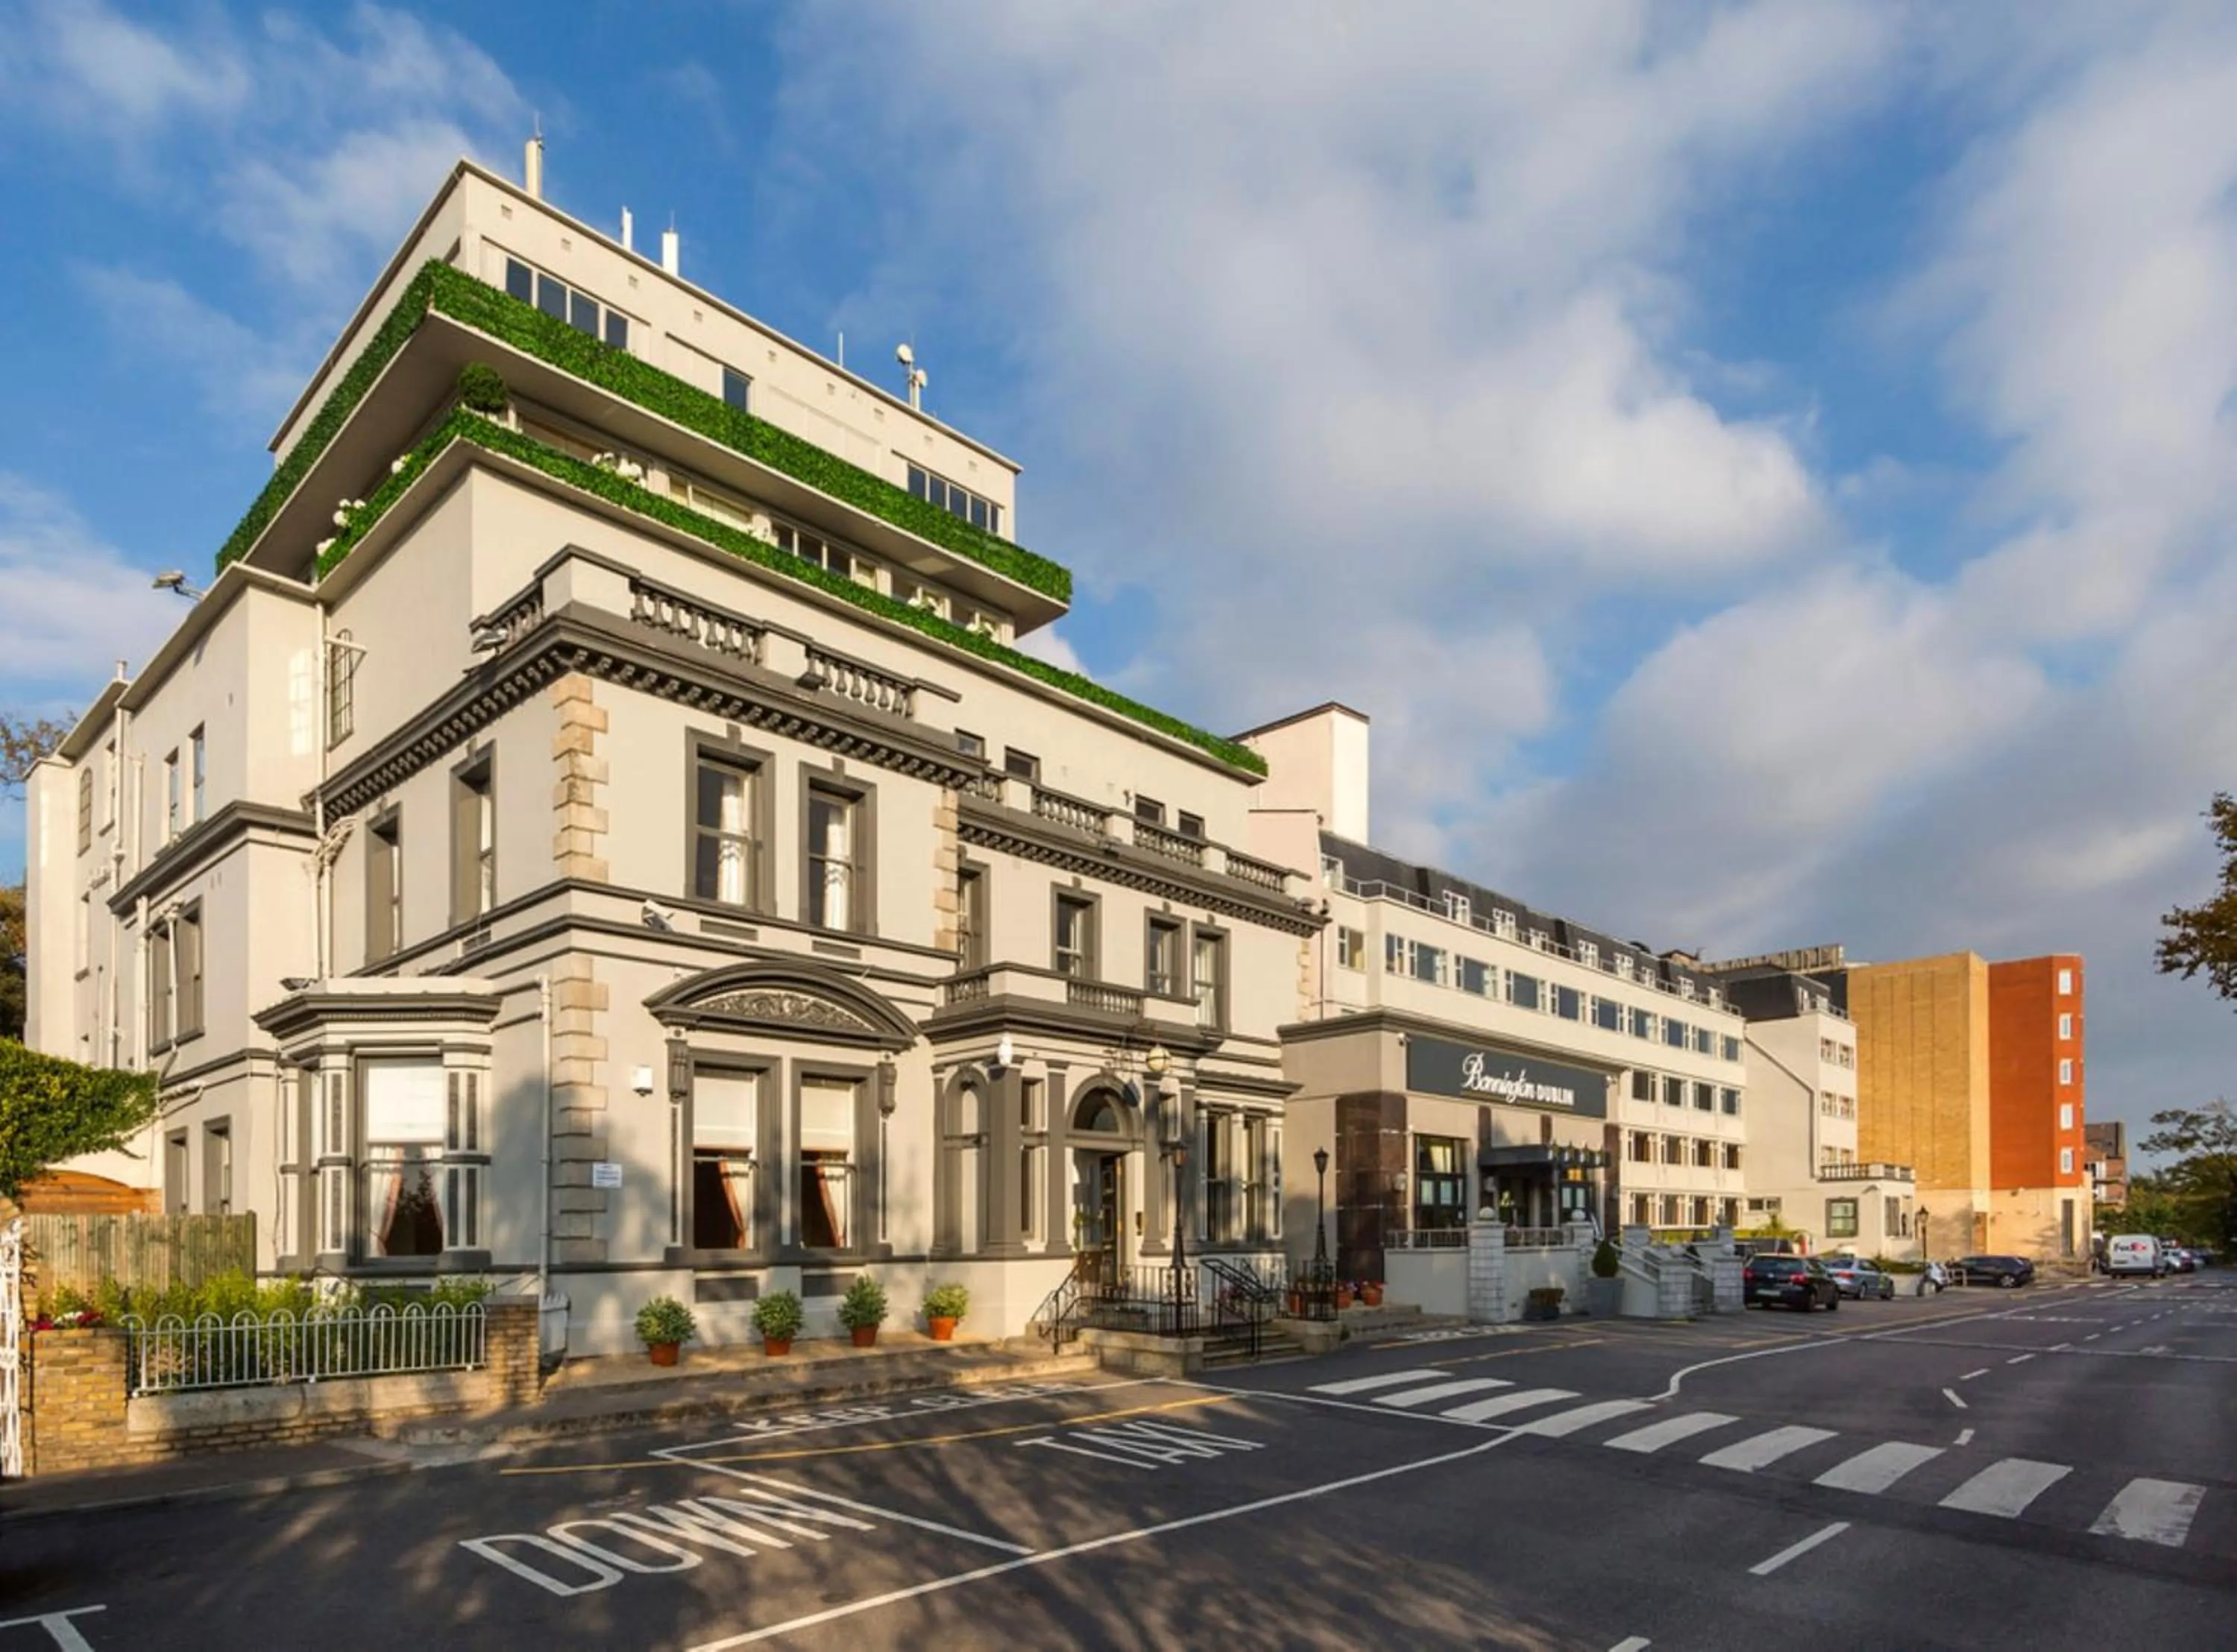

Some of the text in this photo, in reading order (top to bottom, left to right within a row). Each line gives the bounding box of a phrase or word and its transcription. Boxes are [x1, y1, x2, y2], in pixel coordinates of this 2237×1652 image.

[1461, 1053, 1575, 1106] Bonnington DUBLIN
[1013, 1420, 1266, 1470] TAXI
[458, 1489, 877, 1598] DOWN
